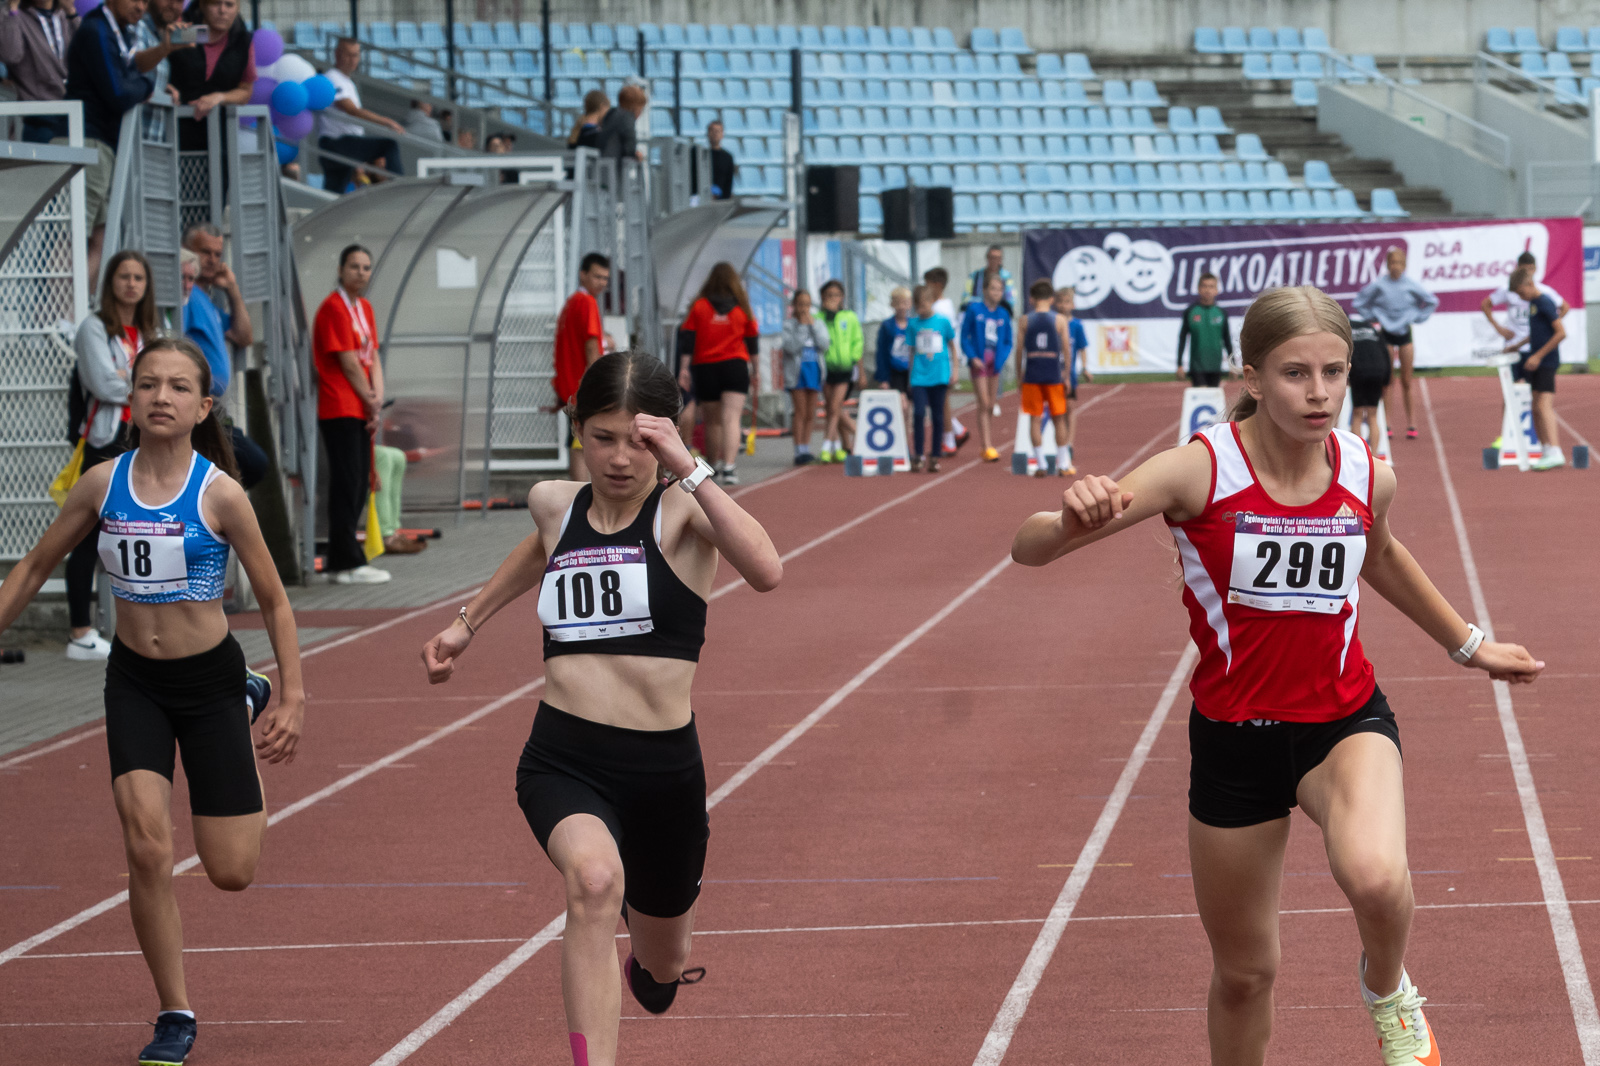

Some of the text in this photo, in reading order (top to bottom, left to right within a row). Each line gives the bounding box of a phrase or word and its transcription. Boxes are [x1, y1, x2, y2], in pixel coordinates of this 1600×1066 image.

[1425, 240, 1463, 258] DLA
[866, 406, 895, 451] 8
[1332, 525, 1346, 534] 2024
[117, 539, 152, 577] 18
[607, 553, 623, 562] 2024
[1252, 540, 1346, 591] 299
[555, 570, 623, 620] 108
